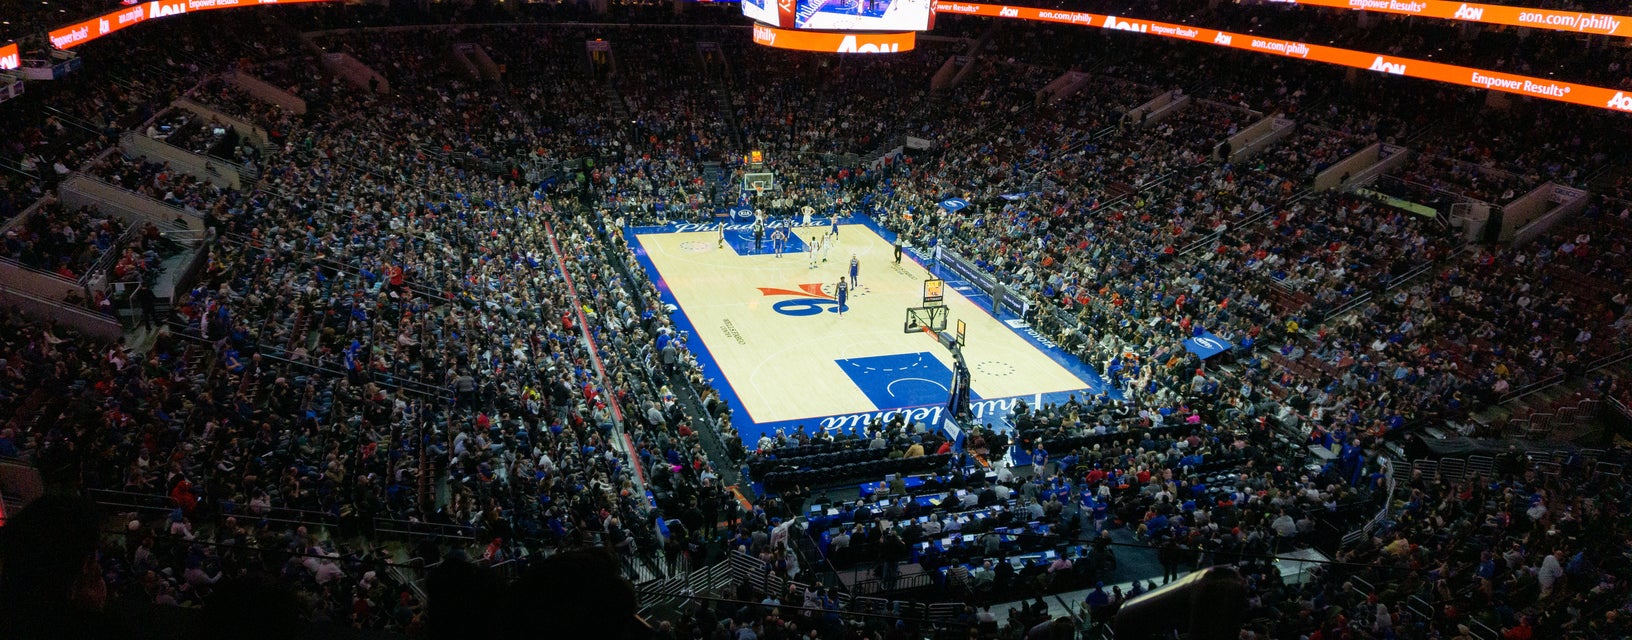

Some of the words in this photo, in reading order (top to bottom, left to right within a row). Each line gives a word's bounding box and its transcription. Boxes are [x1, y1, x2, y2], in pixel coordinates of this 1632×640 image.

[1038, 11, 1092, 25] aon.com/philly
[1518, 11, 1621, 34] aon.com/philly
[1151, 23, 1176, 36] Empower
[1251, 38, 1310, 58] aon.com/philly
[1472, 72, 1523, 91] Empower
[1023, 328, 1056, 348] TOYOTA
